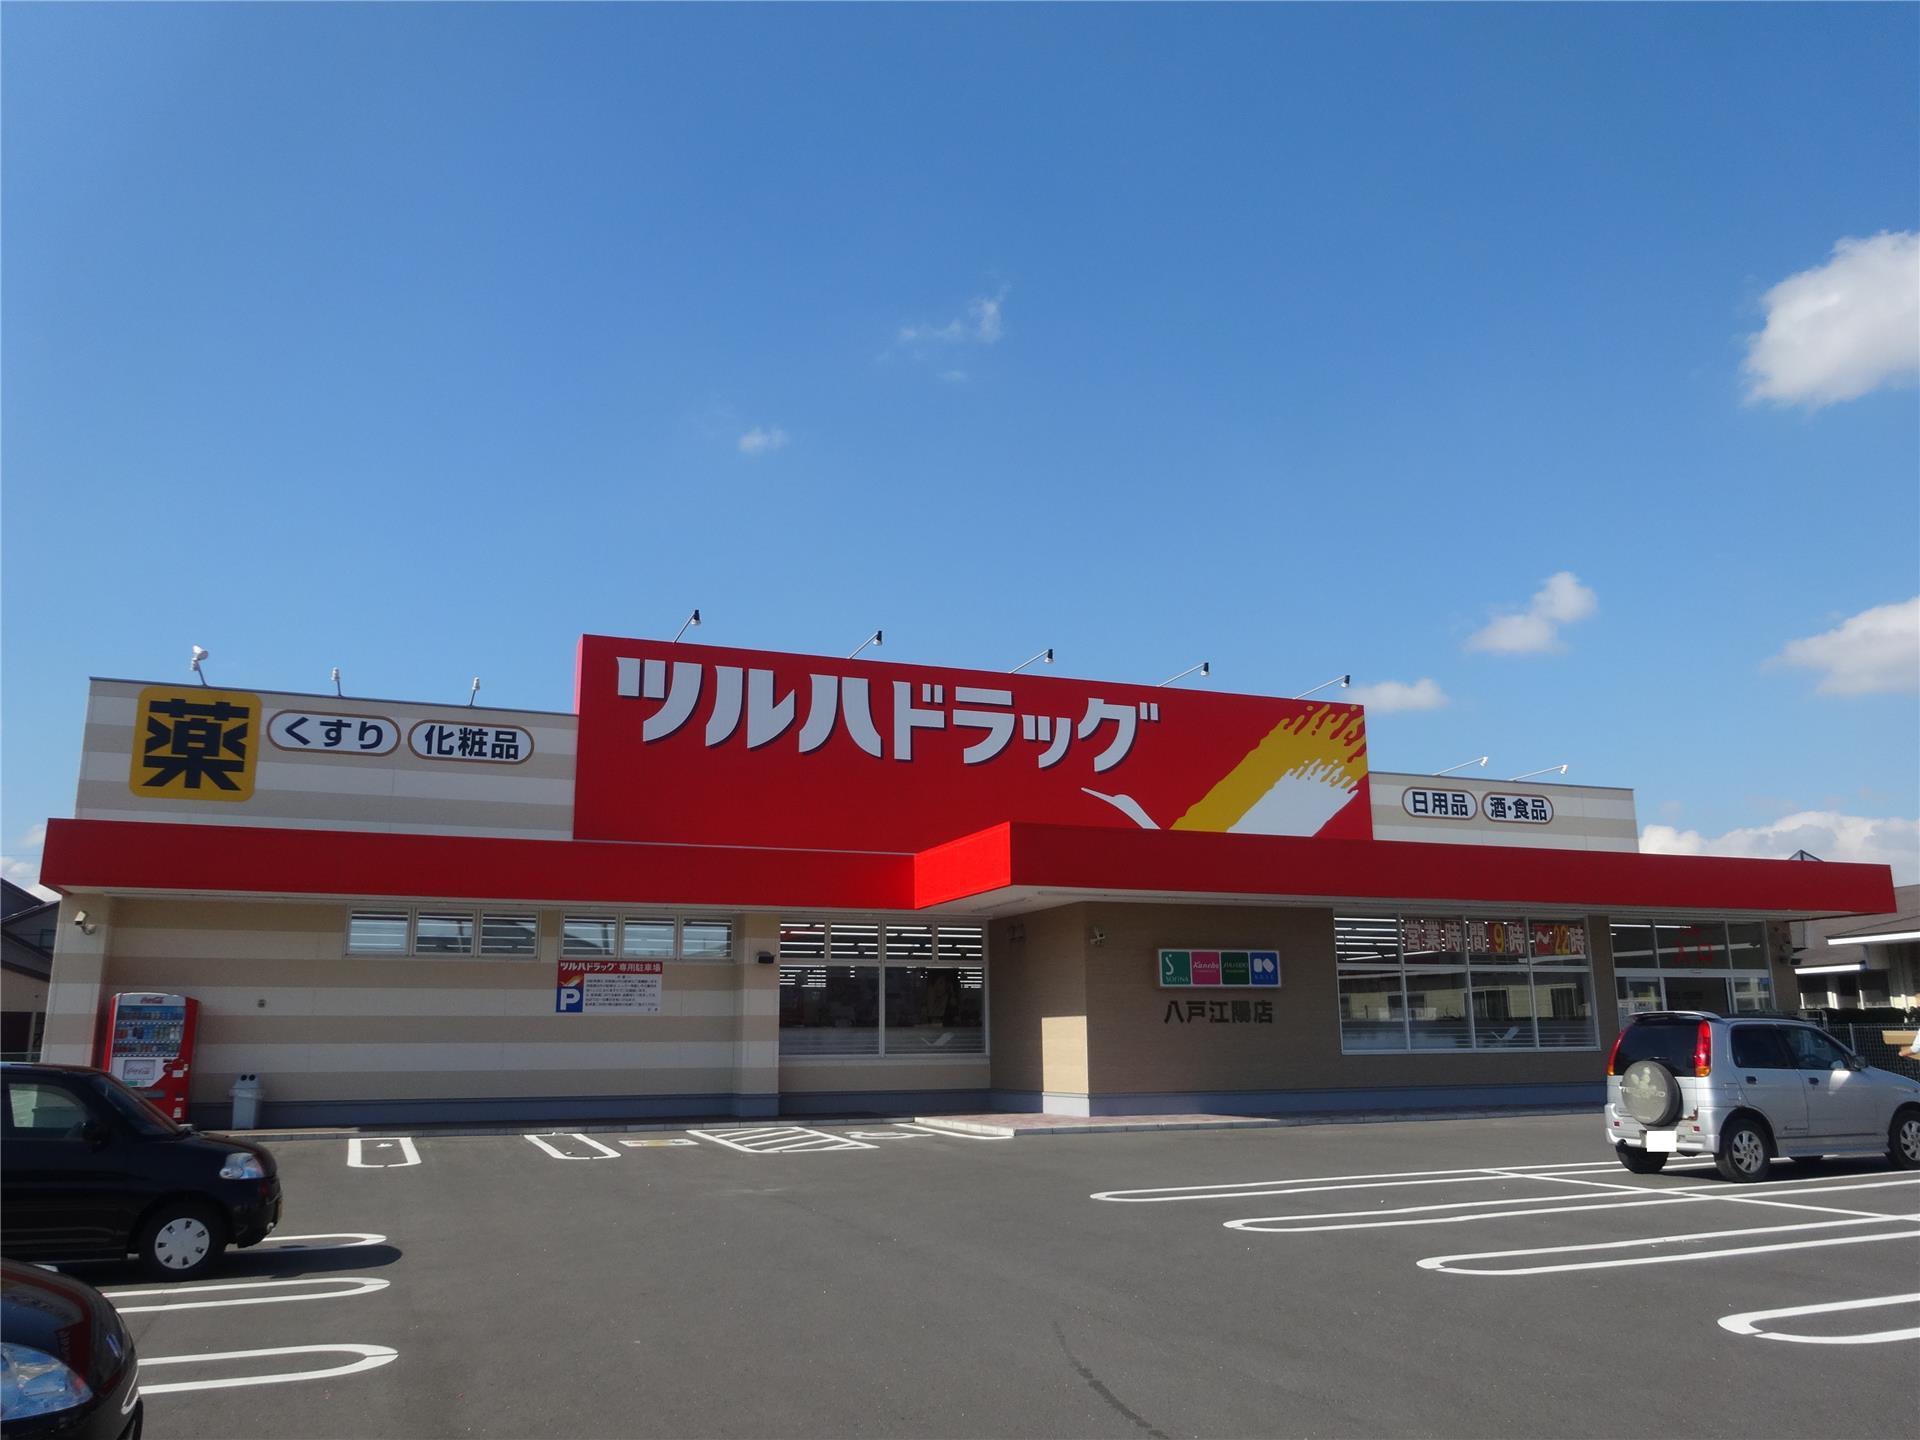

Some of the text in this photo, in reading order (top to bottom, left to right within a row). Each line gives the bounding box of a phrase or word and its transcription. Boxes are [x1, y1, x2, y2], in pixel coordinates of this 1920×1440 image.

[617, 656, 1160, 775] ツルハドラッグ
[142, 698, 250, 792] 薬
[283, 716, 385, 751] くすり
[424, 724, 521, 761] 化粧品
[1411, 790, 1469, 817] 日用品
[560, 962, 618, 971] ツルハドラッグ
[560, 988, 581, 1011] P
